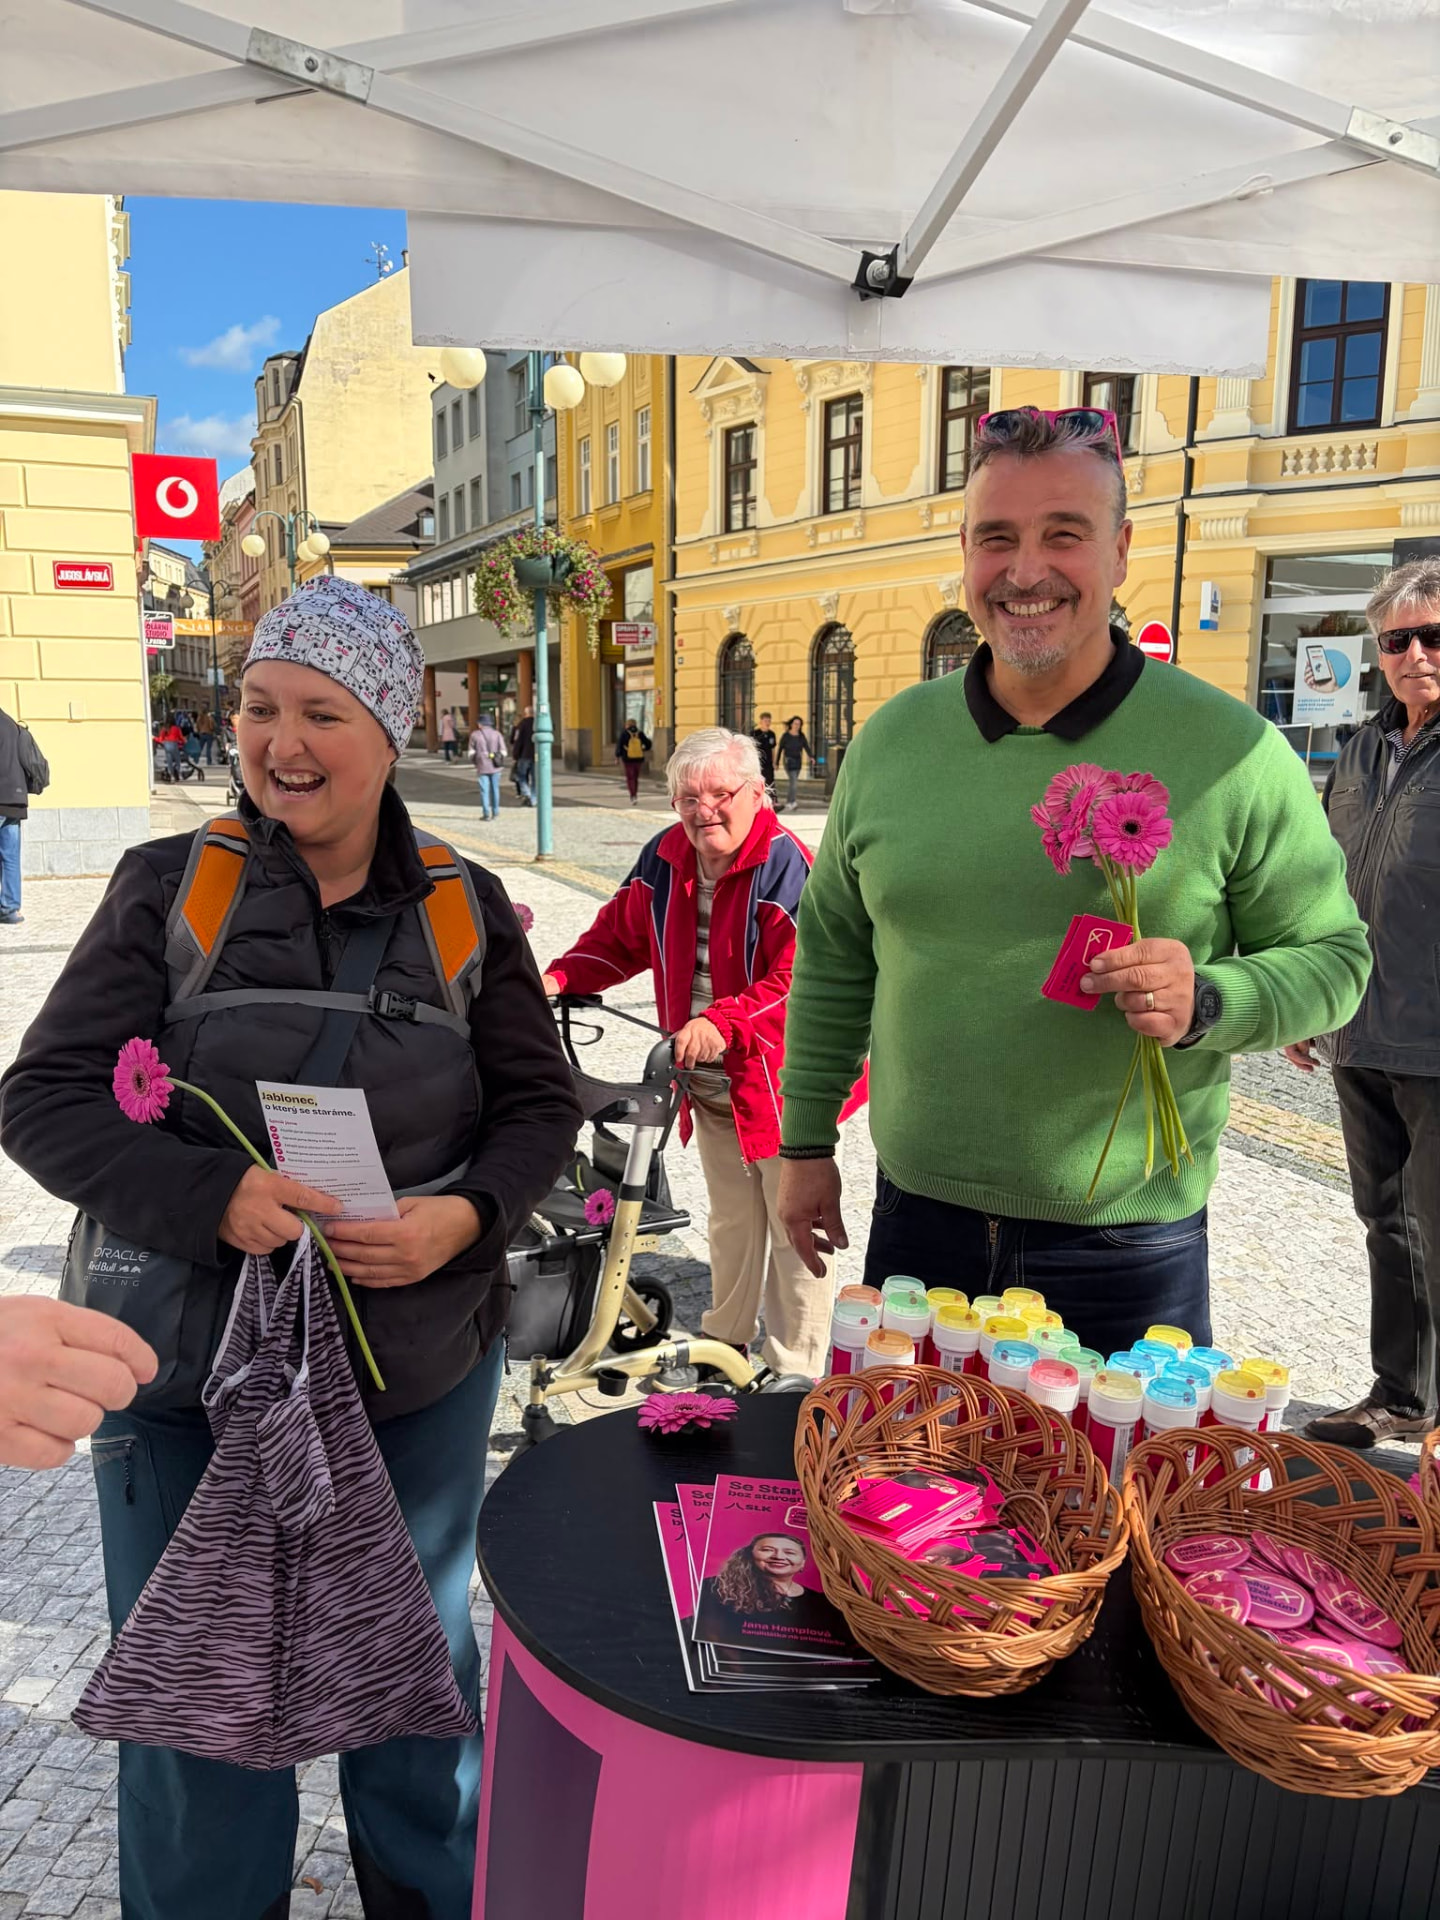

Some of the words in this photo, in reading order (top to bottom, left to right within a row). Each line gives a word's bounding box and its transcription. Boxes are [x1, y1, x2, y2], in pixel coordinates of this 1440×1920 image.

[58, 568, 110, 583] JUGOSLÁVSKÁ
[262, 1091, 318, 1107] Jablonec,
[272, 1104, 298, 1115] který
[312, 1109, 356, 1117] staráme.
[93, 1247, 151, 1262] ORACLE
[88, 1260, 101, 1271] Red
[101, 1261, 117, 1272] Bull
[84, 1275, 141, 1287] RACING
[729, 1481, 754, 1492] Se
[728, 1490, 752, 1499] bez
[693, 1499, 713, 1507] be
[745, 1504, 772, 1513] SLK
[742, 1620, 769, 1630] Jana
[772, 1624, 832, 1638] Hamplová
